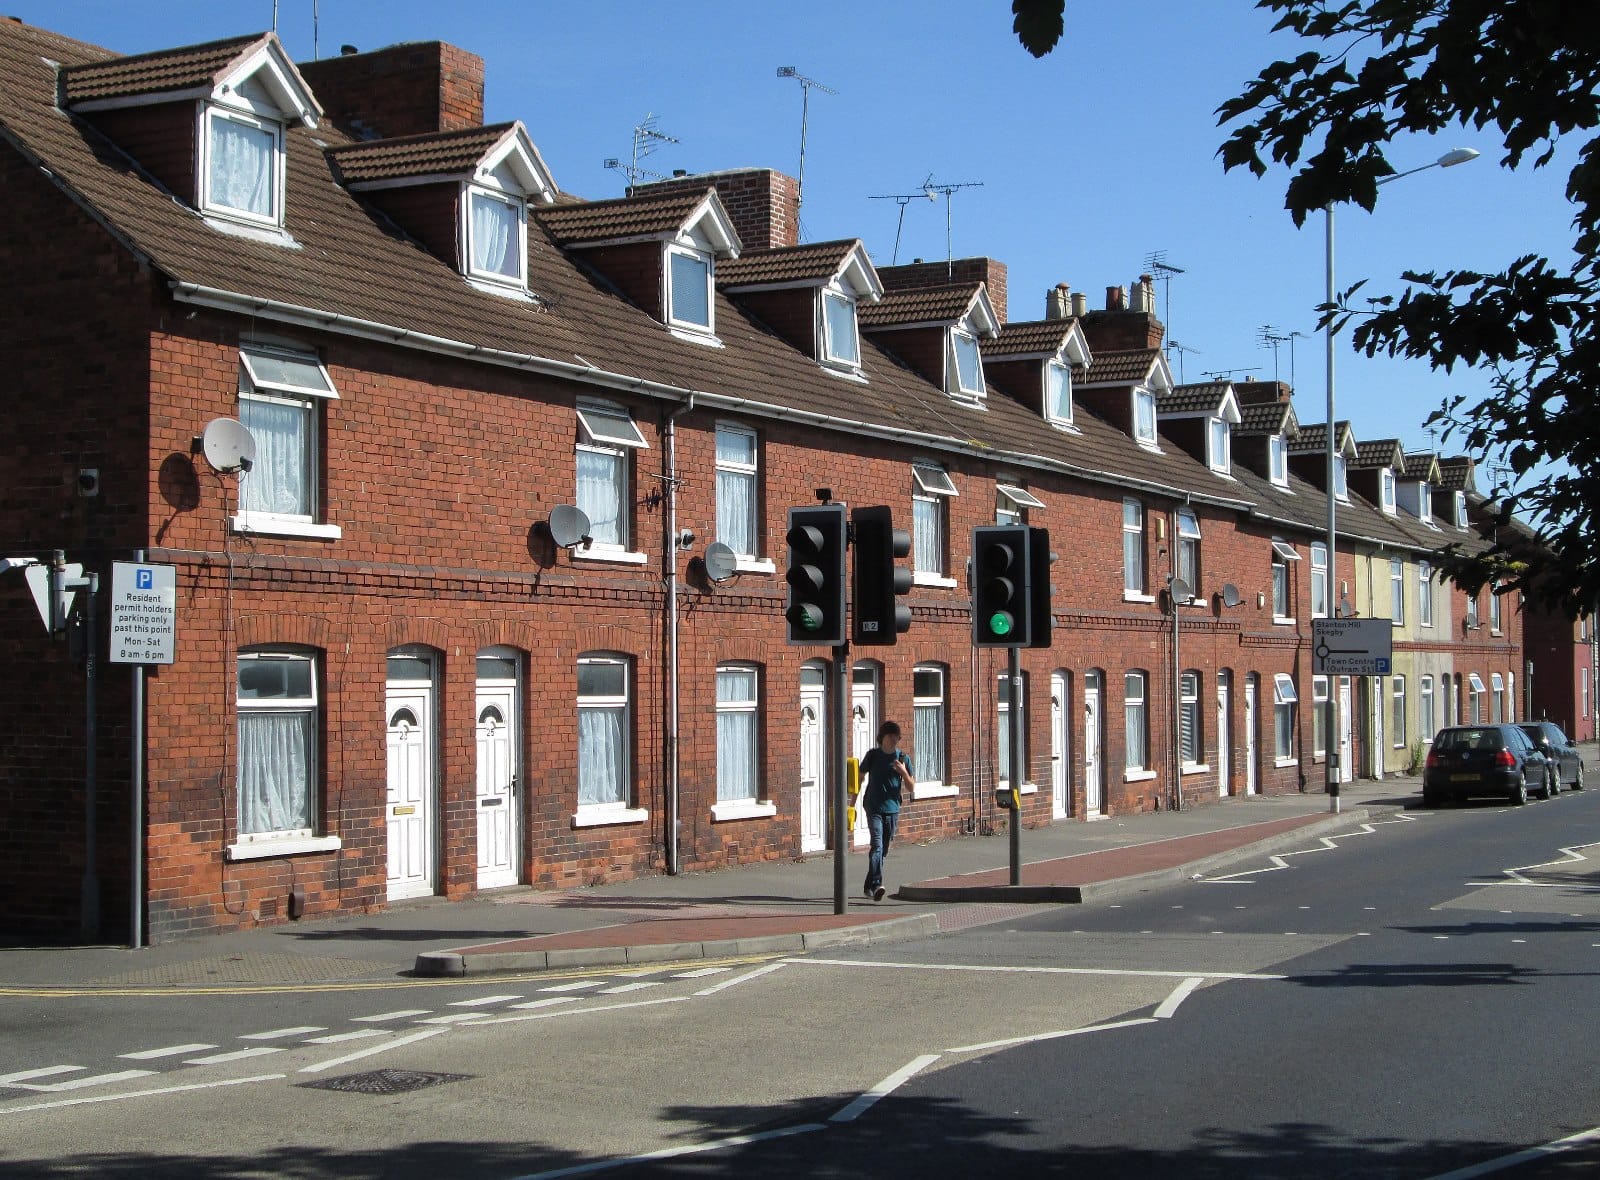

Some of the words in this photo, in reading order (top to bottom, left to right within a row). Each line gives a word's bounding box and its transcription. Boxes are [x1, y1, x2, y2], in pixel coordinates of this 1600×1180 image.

[140, 572, 150, 587] P
[126, 593, 161, 603] Resident
[114, 603, 141, 613] permit
[143, 605, 172, 614] holders
[119, 614, 149, 624] parking
[151, 615, 168, 625] only
[114, 625, 132, 633] past
[134, 625, 149, 633] this
[150, 626, 171, 635] point
[1316, 629, 1344, 637] Skegby
[120, 650, 126, 658] 8
[151, 652, 165, 661] pm
